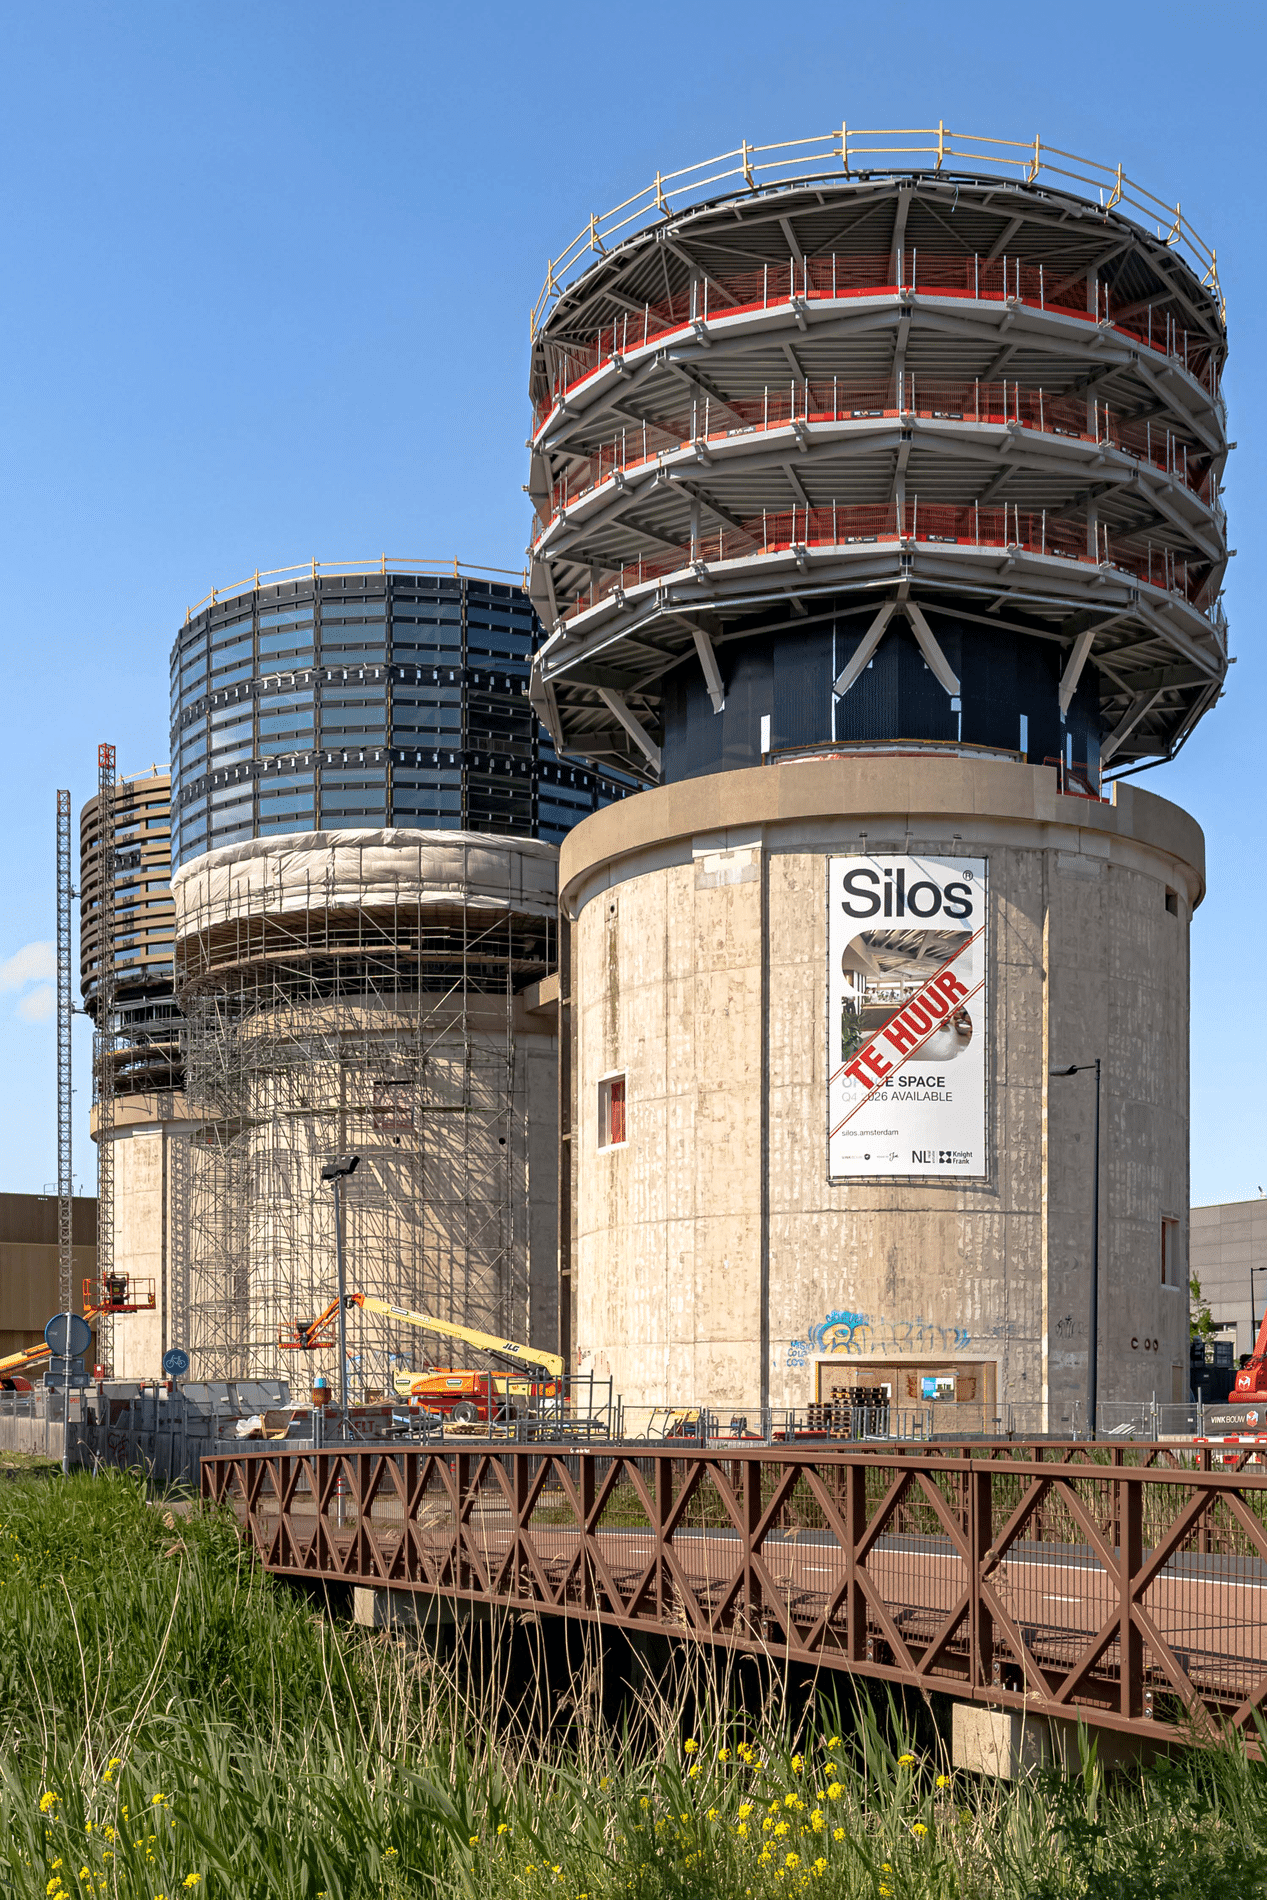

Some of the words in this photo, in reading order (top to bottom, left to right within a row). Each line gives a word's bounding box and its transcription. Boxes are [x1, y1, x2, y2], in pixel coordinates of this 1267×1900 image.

[844, 1044, 894, 1090] TE
[882, 970, 970, 1056] HUUR
[898, 1076, 946, 1088] SPACE
[841, 1092, 857, 1103] Q4
[891, 1091, 953, 1102] AVAILABLE
[841, 1128, 899, 1137] silos.amsterdam
[911, 1150, 931, 1164] NL
[952, 1150, 973, 1159] Knight
[502, 1342, 520, 1353] JLG
